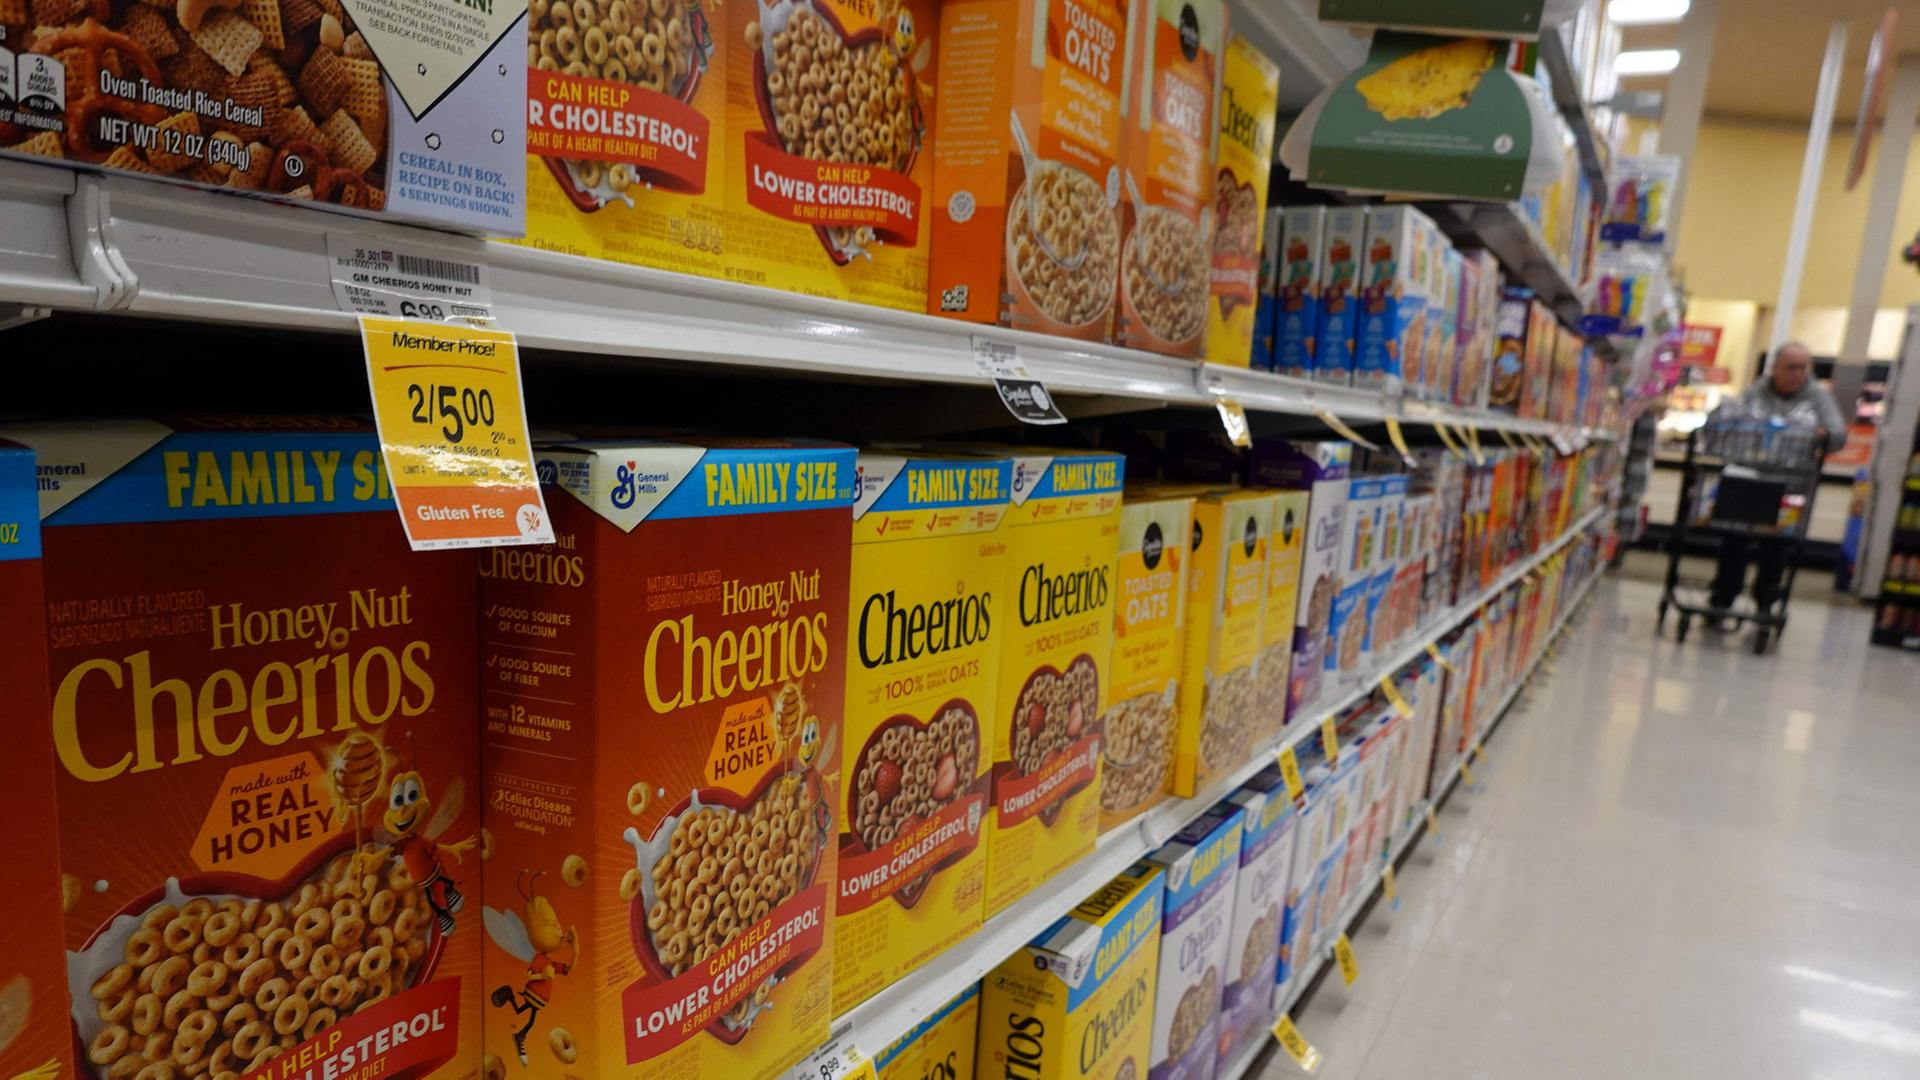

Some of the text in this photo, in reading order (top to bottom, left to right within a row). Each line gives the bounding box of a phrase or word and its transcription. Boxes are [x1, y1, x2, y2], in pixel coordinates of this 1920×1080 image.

[368, 17, 386, 31] SEE
[387, 24, 411, 38] BACK
[1064, 0, 1116, 52] TOASTED
[1065, 28, 1111, 85] OATS
[100, 69, 263, 128] Oven Toasted Rice Cereal
[547, 79, 630, 109] CAN HELP
[100, 116, 252, 172] NET WT 12 OZ (340g)
[527, 130, 658, 161] PART OF A HEART HEALTHY DIET
[399, 151, 506, 188] CEREAL IN BOX,
[753, 164, 816, 205] LOWER
[817, 166, 871, 185] CAN HELP
[398, 170, 515, 206] RECIPE ON BACK!
[398, 188, 513, 219] 4 SERVINGS SHOWN.
[352, 273, 472, 296] GM CHEERIOS HONEY NUT
[392, 332, 496, 356] Member Price!
[163, 451, 398, 508] FAMILY SI
[637, 472, 670, 483] General
[638, 485, 658, 494] Mills
[704, 462, 838, 506] FAMILY SIZE
[908, 468, 1000, 503] FAMILY SIZE
[1053, 464, 1093, 492] FAMILY
[1095, 462, 1116, 488] SIZE
[417, 504, 505, 521] Gluten Free
[722, 568, 821, 618] Honey Nut
[1018, 562, 1109, 628] Cheerios
[1125, 572, 1172, 596] TOASTED
[50, 590, 205, 622] NATURALLY FLAVORED
[211, 586, 413, 649] Honey Nut
[500, 606, 571, 626] GOOD SOURCE
[1126, 592, 1169, 625] OATS
[500, 621, 557, 638] OF CALCIUM
[858, 589, 991, 669] Cheerios
[500, 657, 571, 677] GOOD SOURCE
[501, 671, 539, 686] OF FIBER
[643, 612, 828, 714] Cheerios
[949, 659, 979, 683] OATS
[885, 674, 924, 700] 100%
[52, 641, 435, 783] Cheerios
[488, 705, 571, 731] WITH 12 VITAMINS
[508, 725, 551, 742] MINERALS
[726, 721, 768, 753] REAL
[715, 740, 776, 780] HONEY
[230, 761, 311, 796] made with
[231, 783, 318, 827] REAL
[504, 791, 572, 815] Celiac Disease
[1003, 788, 1036, 815] LOWER
[211, 806, 336, 864] HONEY
[893, 814, 941, 856] CAN HELP
[841, 864, 889, 897] LOWER
[709, 918, 772, 976] CAN HELP
[1095, 895, 1158, 981] GIANT SIZE
[635, 985, 709, 1038] LOWER
[681, 1019, 692, 1035] AS
[693, 1005, 712, 1029] PART
[729, 978, 750, 1001] HEART
[1079, 975, 1148, 1075] Cheerios
[282, 1030, 342, 1079] HELP
